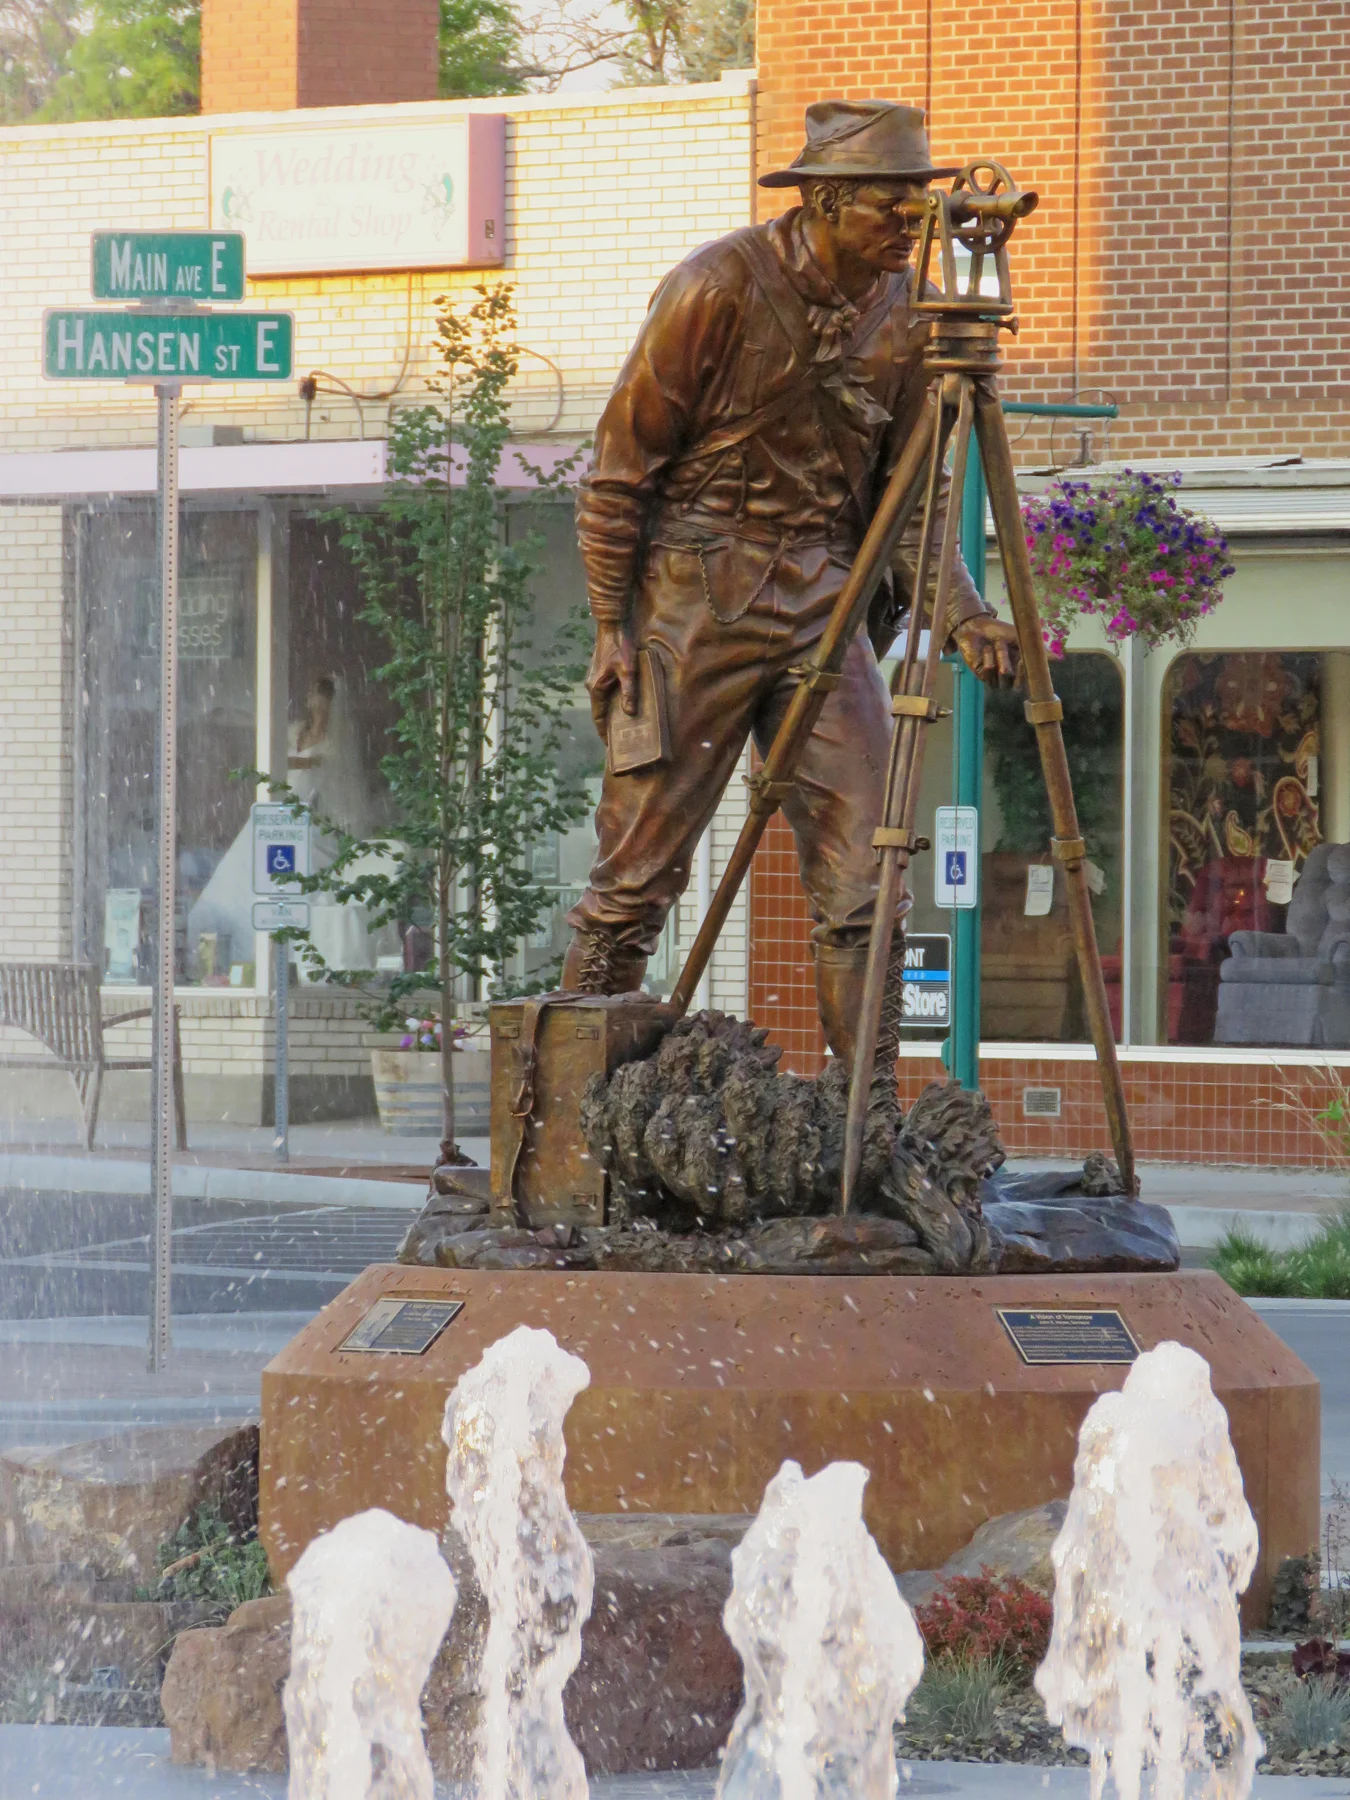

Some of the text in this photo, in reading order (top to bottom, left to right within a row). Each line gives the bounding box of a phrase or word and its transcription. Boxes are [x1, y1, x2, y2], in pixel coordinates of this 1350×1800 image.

[254, 140, 421, 194] Wedding
[257, 204, 413, 248] Rental Shop
[110, 240, 227, 293] MAIN AVE E
[57, 319, 280, 372] HANSEN ST E
[258, 829, 304, 841] PARKING
